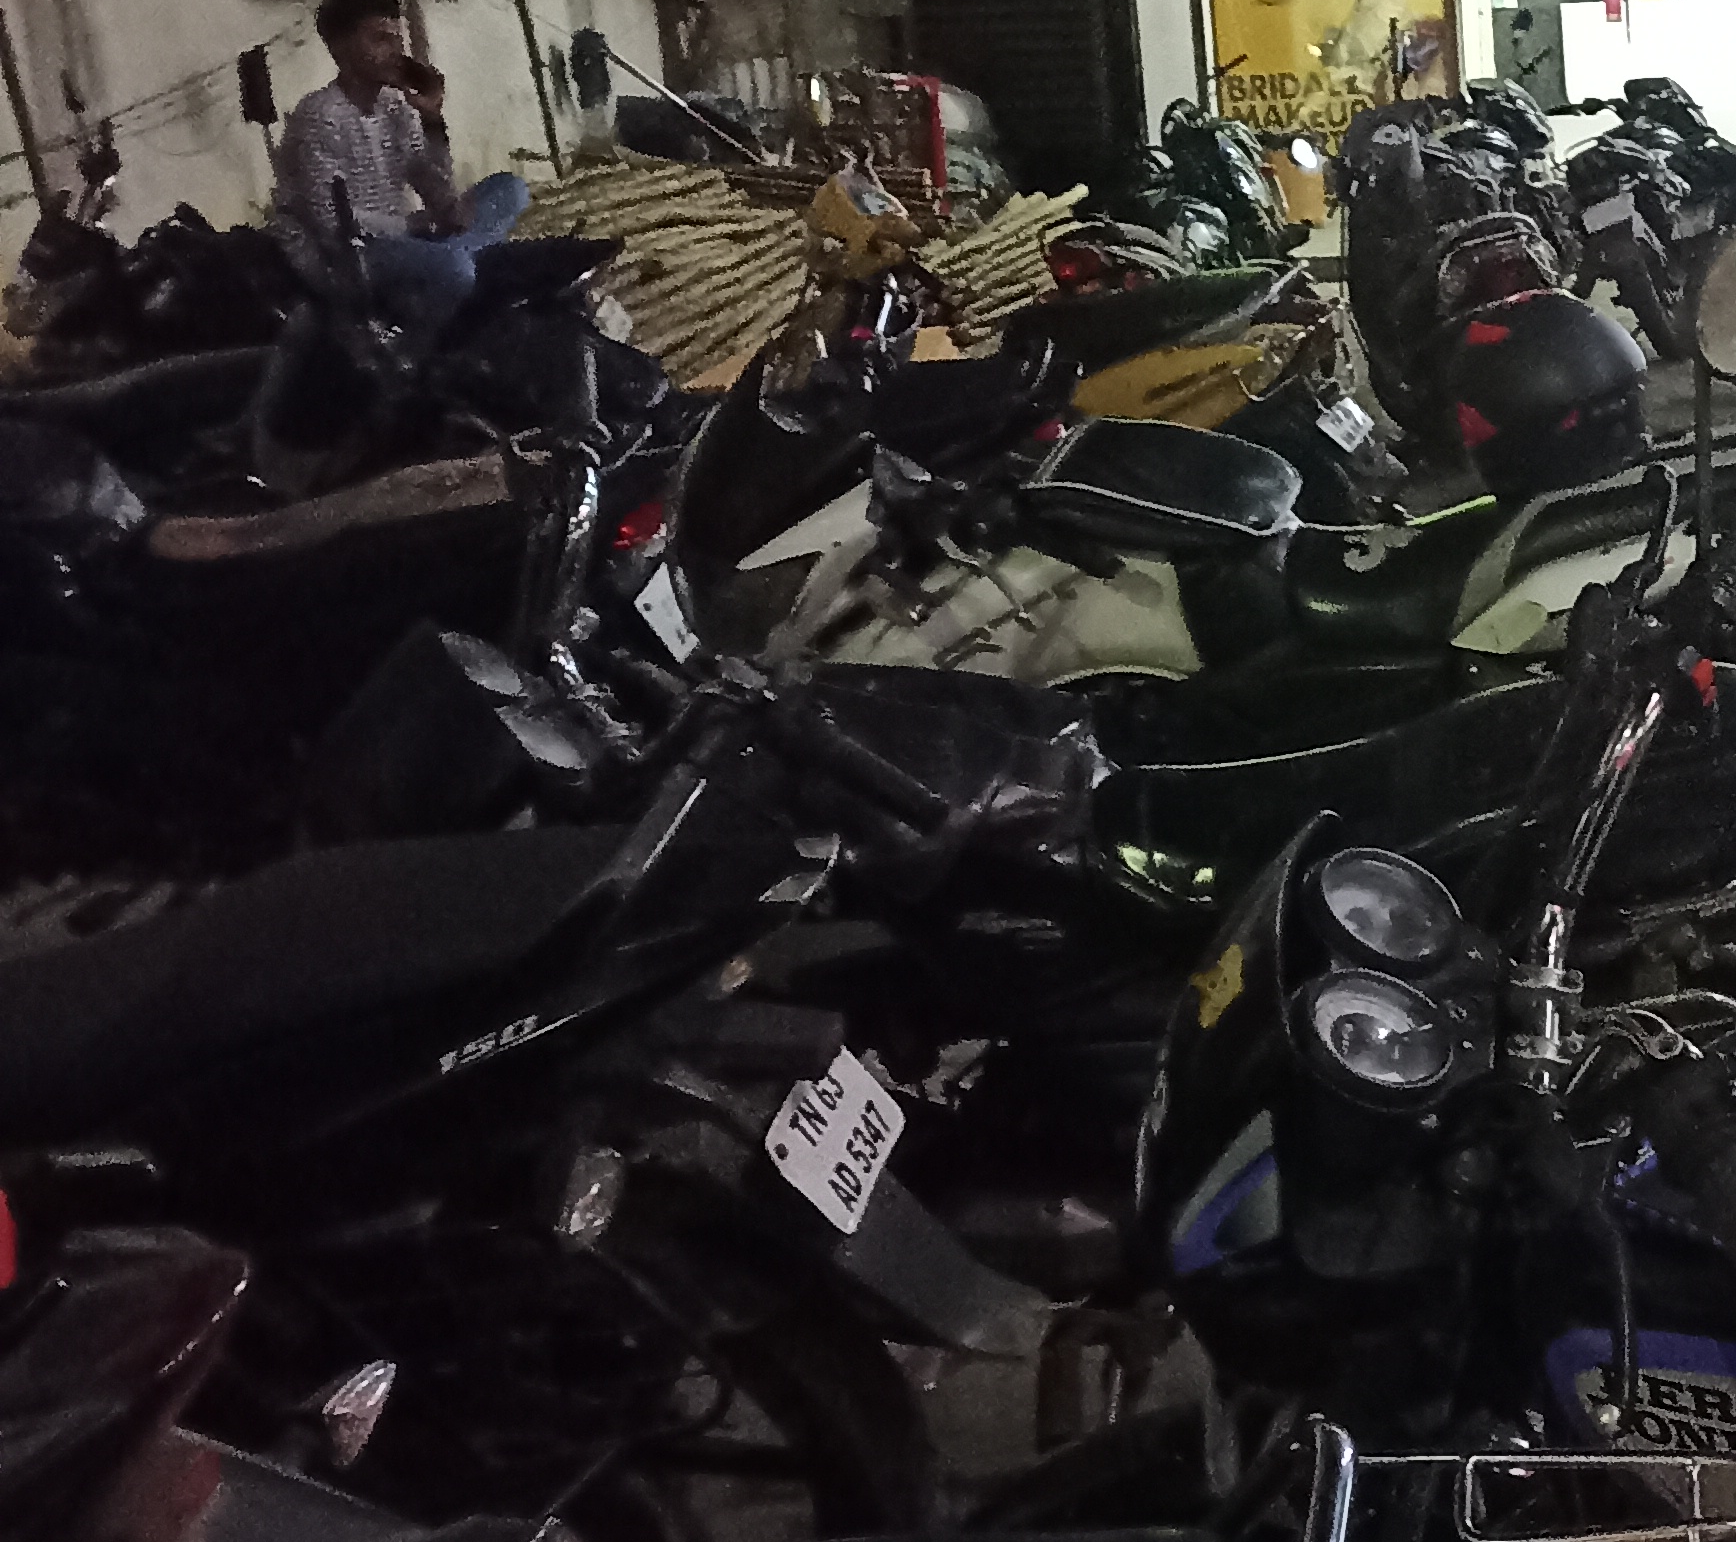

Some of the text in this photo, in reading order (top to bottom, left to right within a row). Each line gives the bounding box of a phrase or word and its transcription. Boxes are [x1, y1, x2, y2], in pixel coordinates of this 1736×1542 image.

[1226, 72, 1345, 102] BRIDAL
[788, 1096, 829, 1148] TN
[827, 1099, 891, 1214] AD 5347
